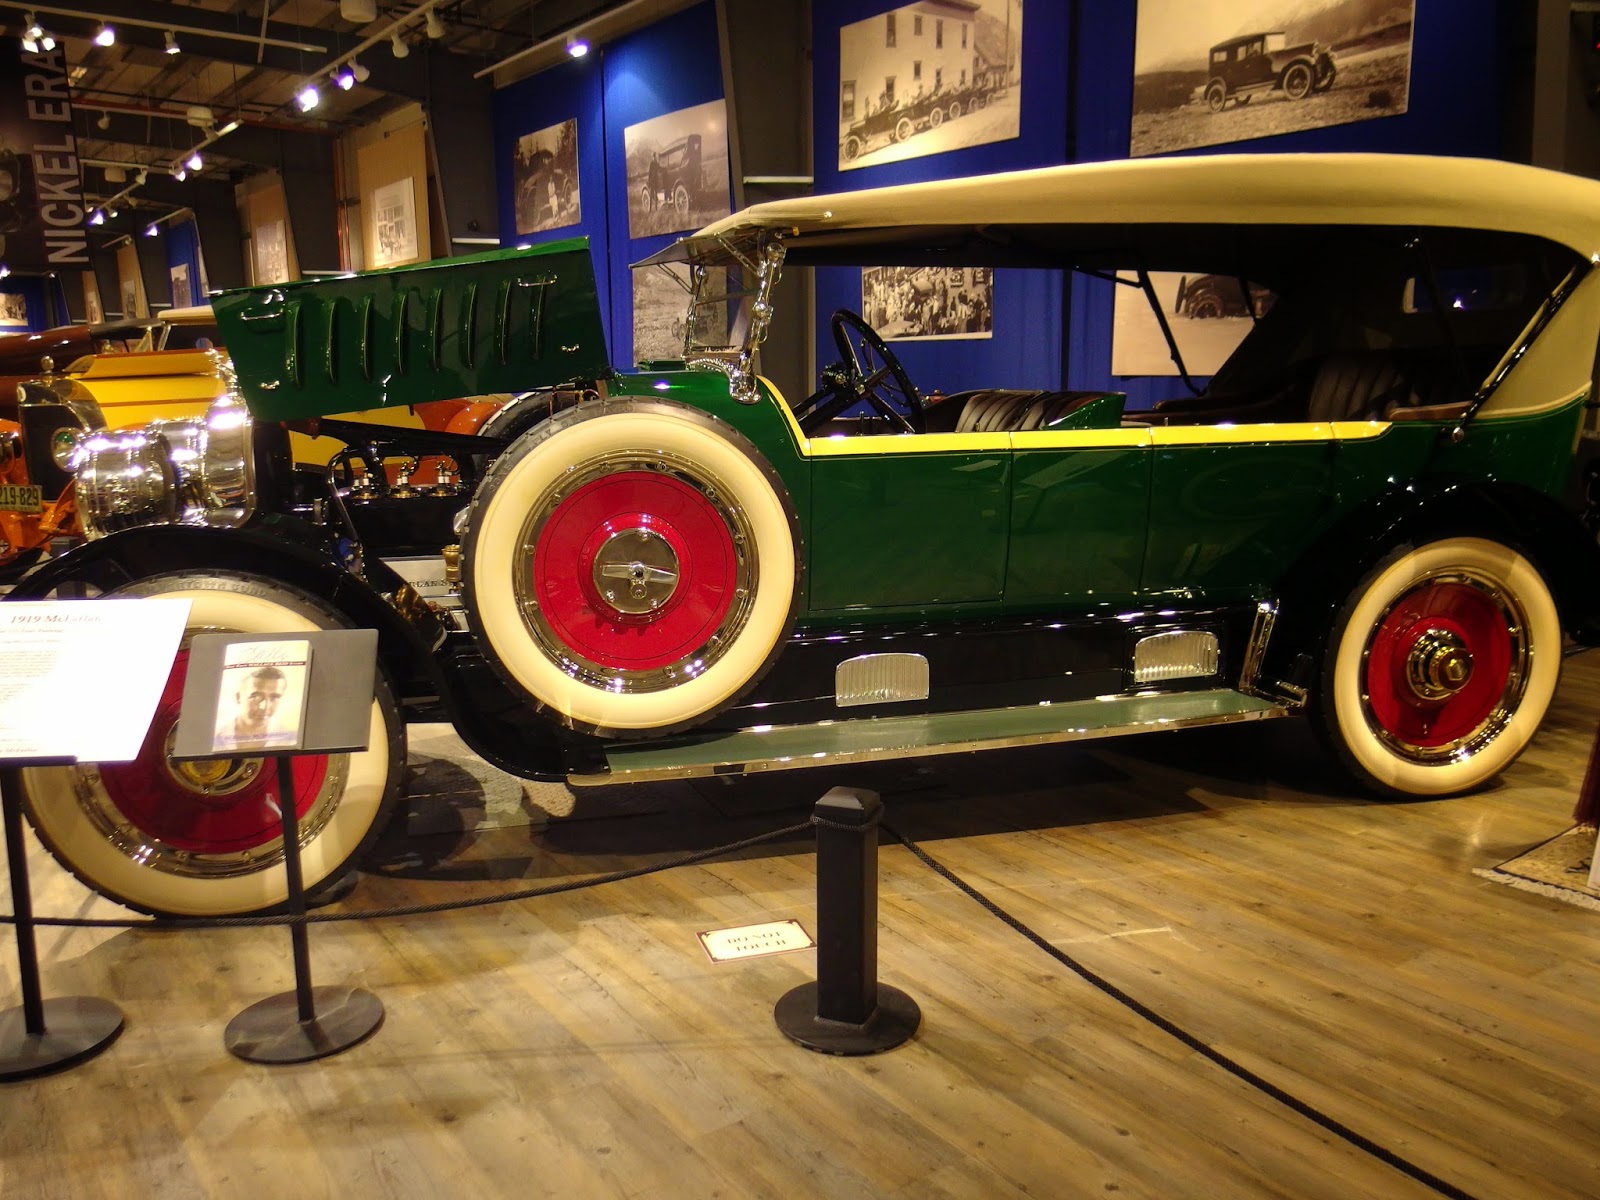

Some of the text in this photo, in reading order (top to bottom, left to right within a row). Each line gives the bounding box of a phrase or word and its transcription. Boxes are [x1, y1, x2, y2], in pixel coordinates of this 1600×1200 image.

[21, 46, 90, 263] NICKEL ERA
[11, 615, 41, 623] 1919
